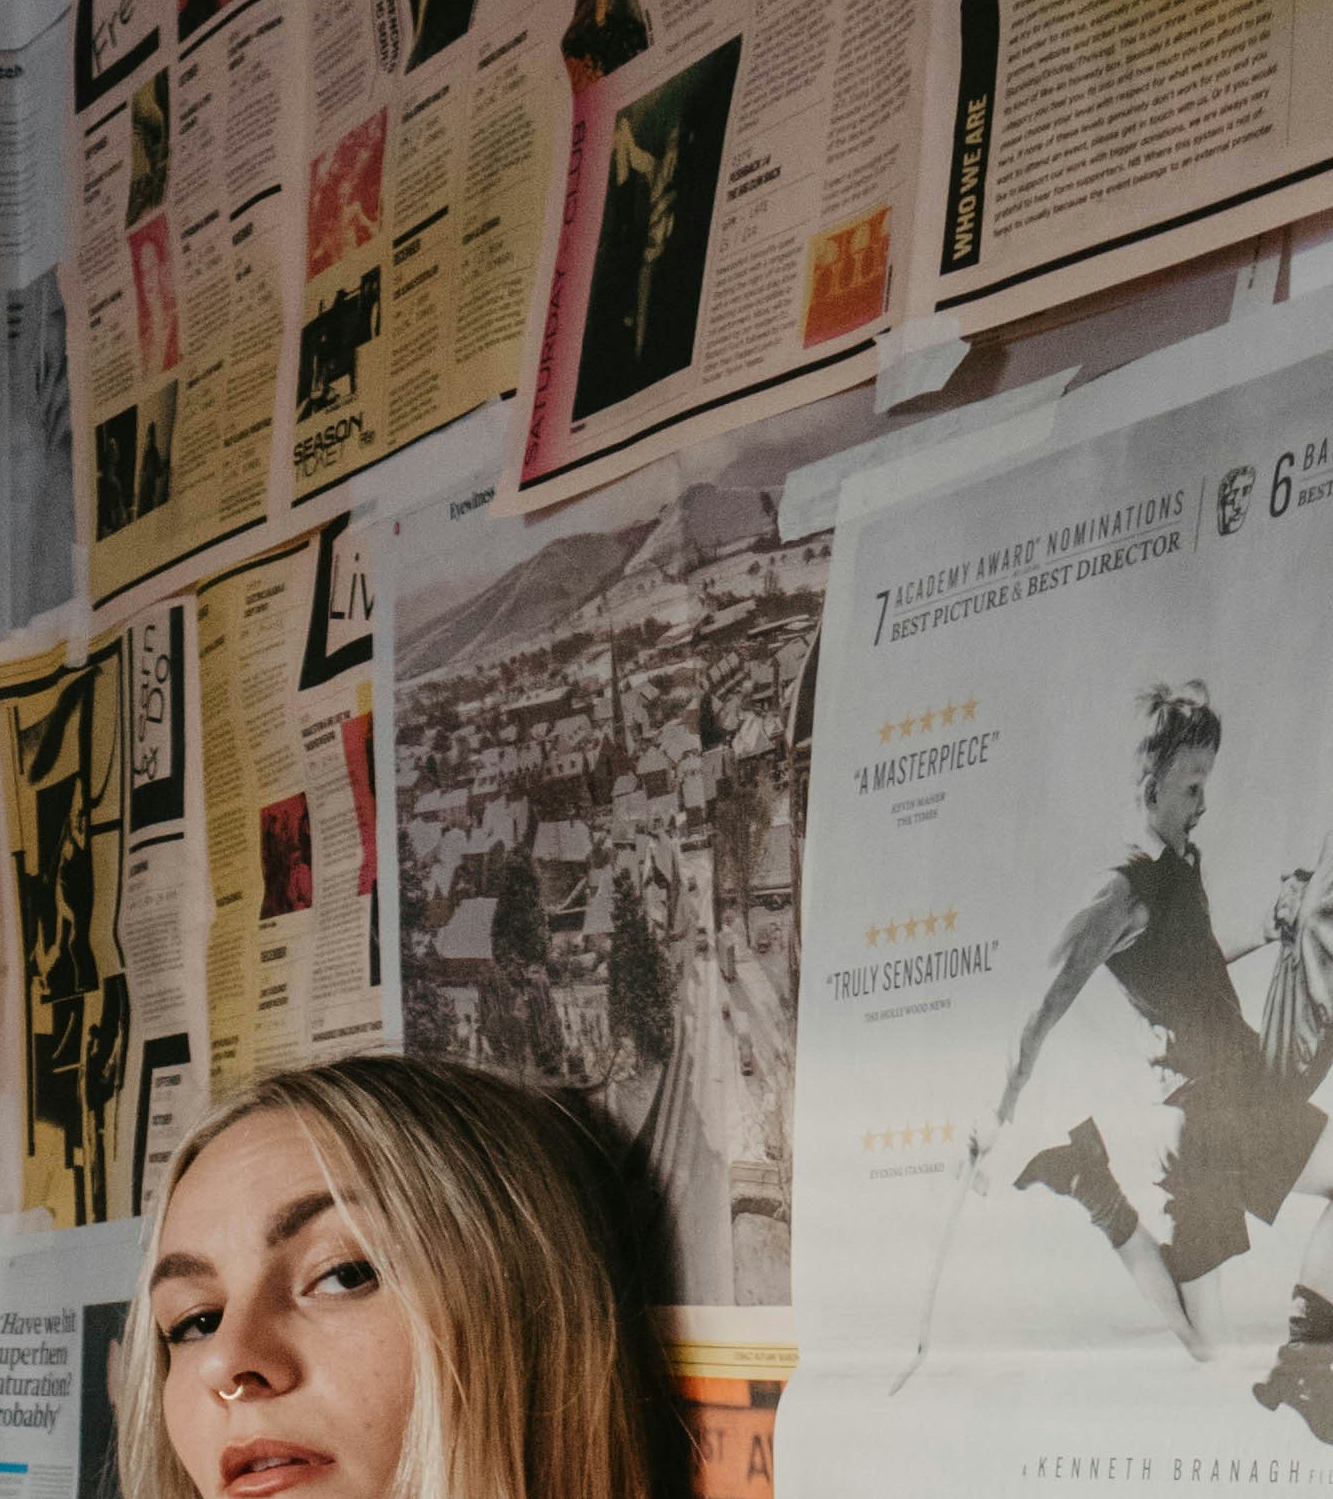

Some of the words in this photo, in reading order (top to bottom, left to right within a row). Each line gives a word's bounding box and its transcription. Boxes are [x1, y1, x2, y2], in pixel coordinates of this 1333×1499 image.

[965, 94, 989, 150] ARE
[959, 148, 982, 193] WE
[952, 192, 978, 262] WHO
[524, 270, 566, 468] SATURDAY
[563, 119, 588, 240] CLUB
[293, 411, 365, 466] SEASON
[448, 484, 497, 521] Eyewitness
[1267, 451, 1296, 519] 6
[894, 560, 972, 608] ACADEMY
[1045, 489, 1187, 557] NOMINATIONS
[889, 612, 932, 643] BEST
[932, 585, 1010, 630] PICTURE
[1011, 583, 1024, 602] &
[1026, 565, 1073, 598] BEST
[1075, 530, 1182, 585] DIRECTOR
[873, 589, 892, 647] 7
[146, 654, 171, 724] Do
[43, 1314, 63, 1335] we
[1037, 1455, 1152, 1482] KENNETH
[1172, 1458, 1302, 1485] BRANAGH
